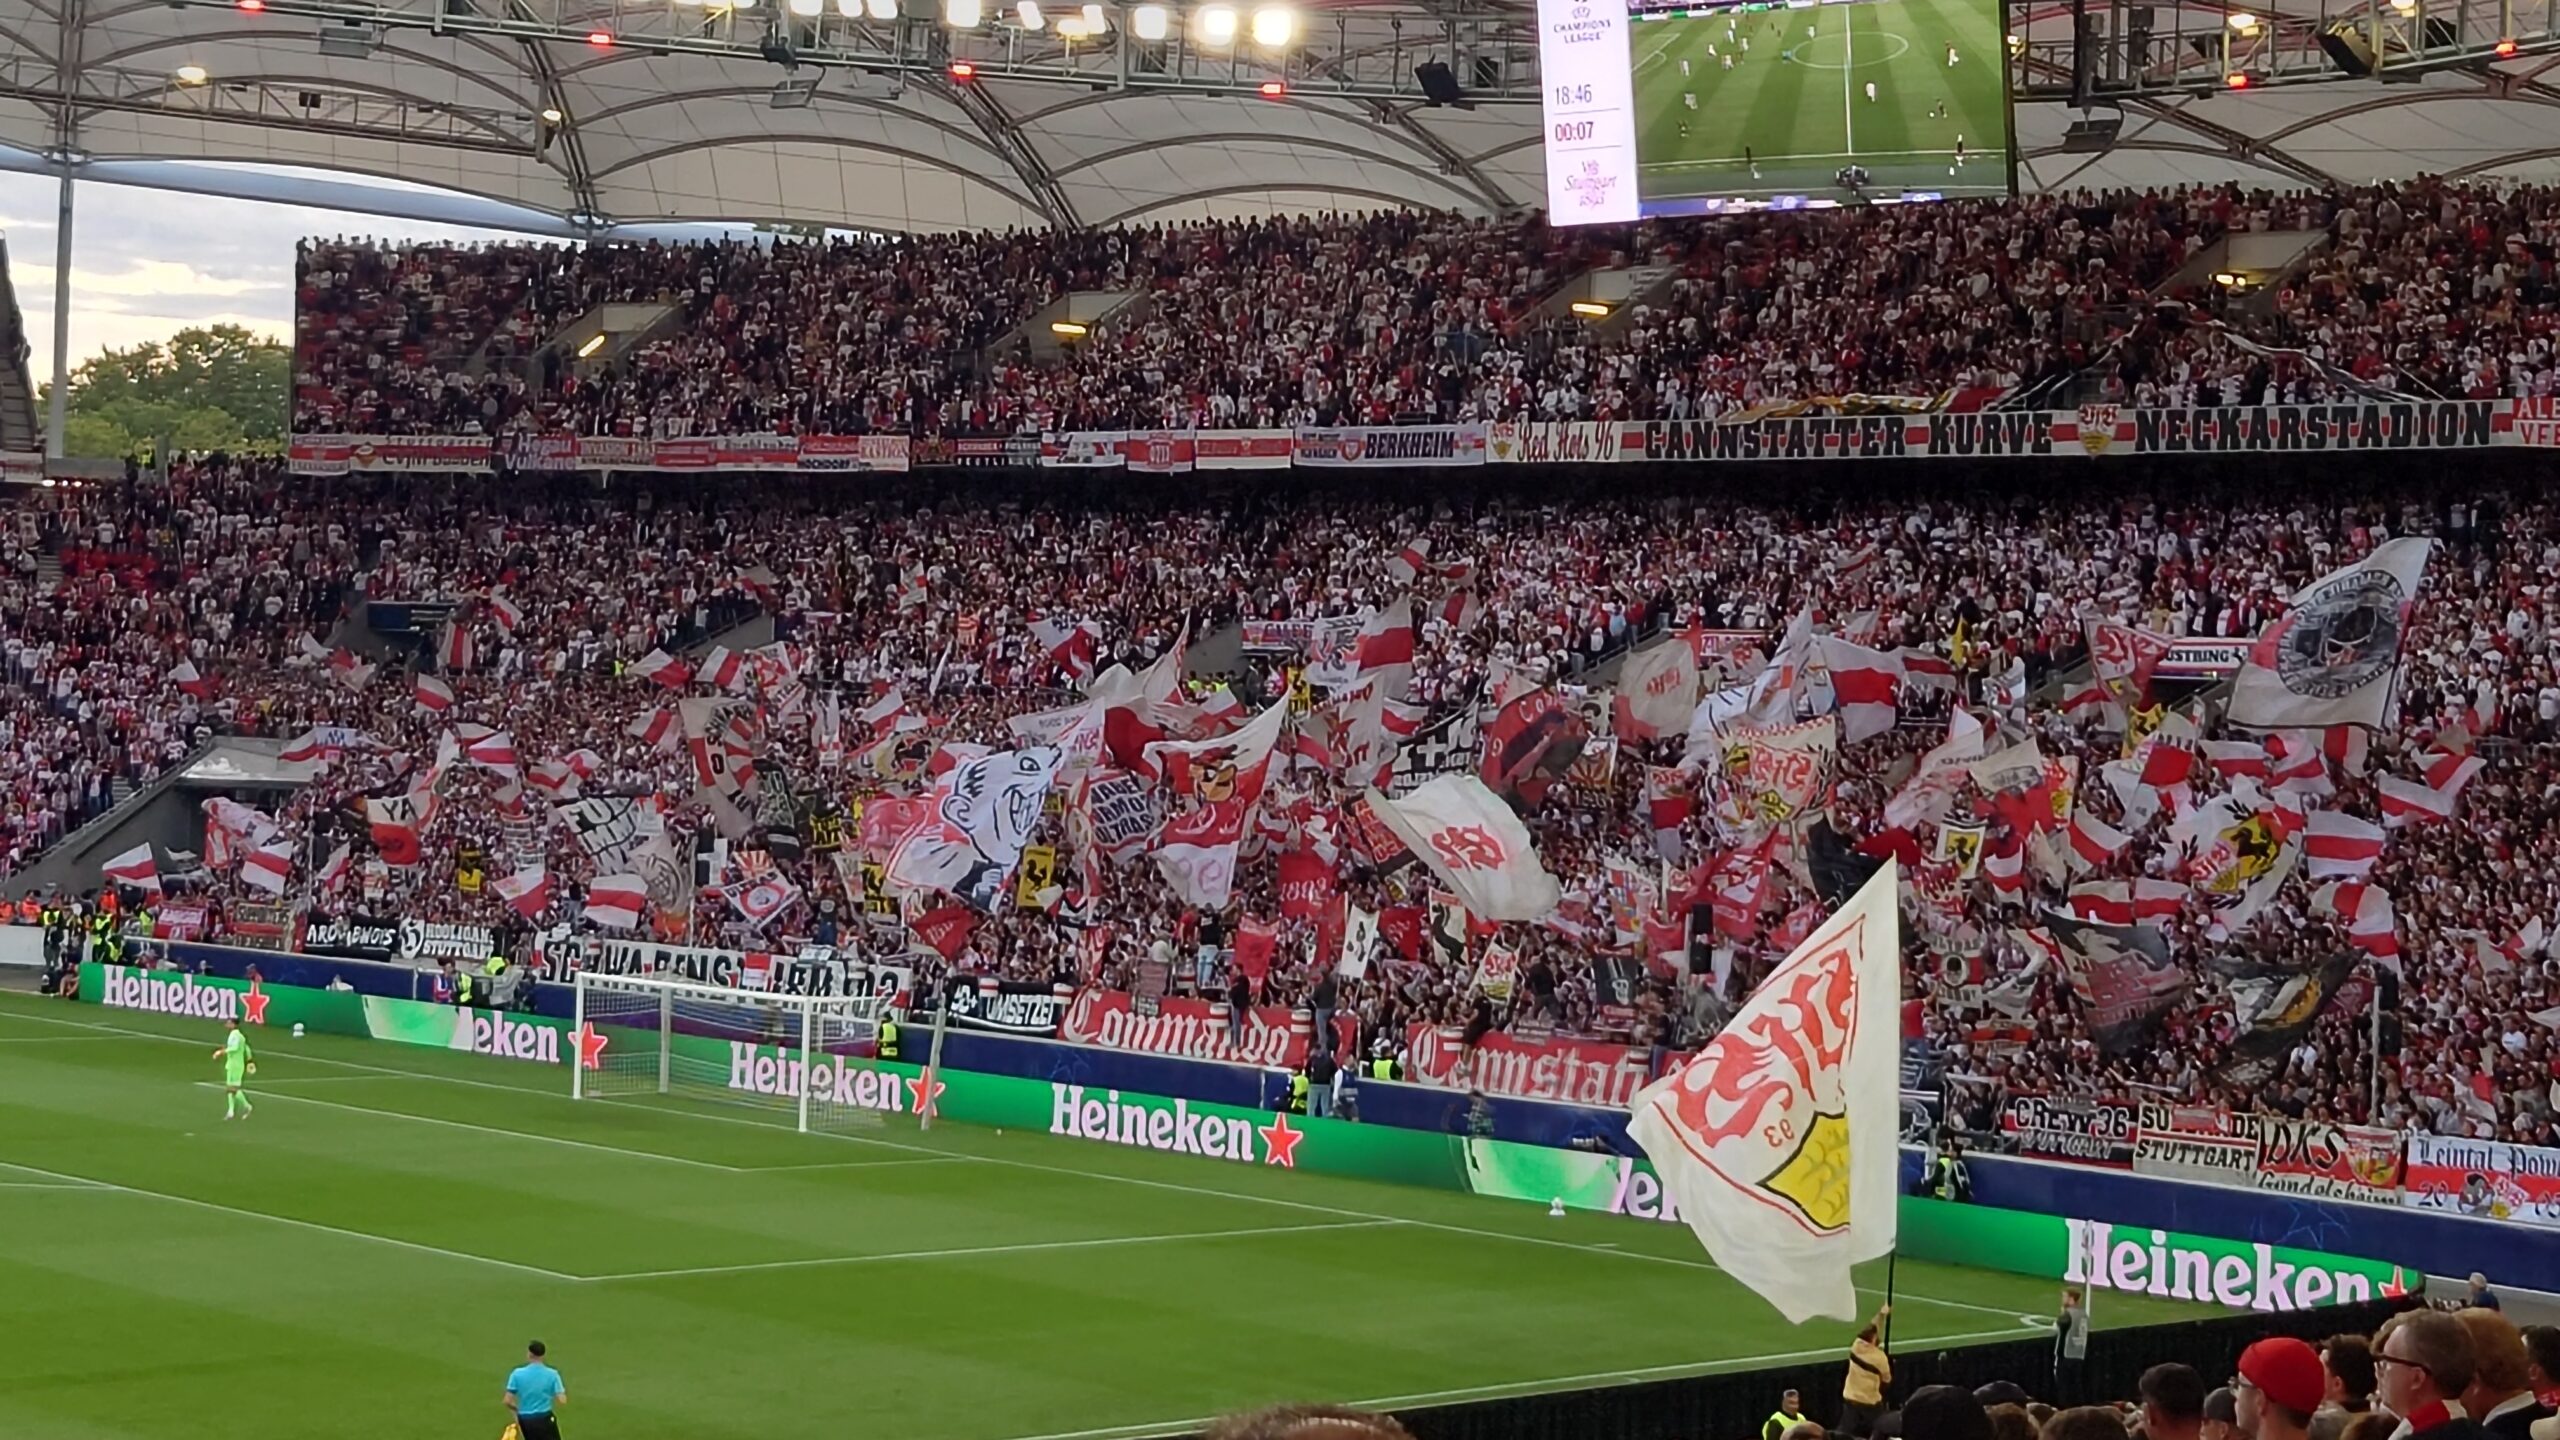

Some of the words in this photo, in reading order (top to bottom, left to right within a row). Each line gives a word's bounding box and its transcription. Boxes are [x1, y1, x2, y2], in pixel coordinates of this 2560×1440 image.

[1555, 84, 1592, 105] 18:46
[1555, 121, 1594, 141] 00:07
[1645, 414, 1907, 461] CANNSTATTER
[1928, 408, 2053, 458] KURVE
[2134, 402, 2493, 453] NECKARSTADION
[1365, 432, 1455, 459] BERKHEIM
[2166, 650, 2230, 664] USTRING
[425, 923, 496, 944] HOOLIGAN
[103, 965, 237, 1019] Heineken
[951, 983, 984, 1014] 50+
[472, 1006, 561, 1064] eken
[1062, 990, 1292, 1067] Commando
[1050, 1083, 1255, 1162] Heineken
[2136, 1140, 2256, 1172] STUTTGART
[2417, 1137, 2494, 1172] Leintal
[2062, 1217, 2370, 1312] Heineken
